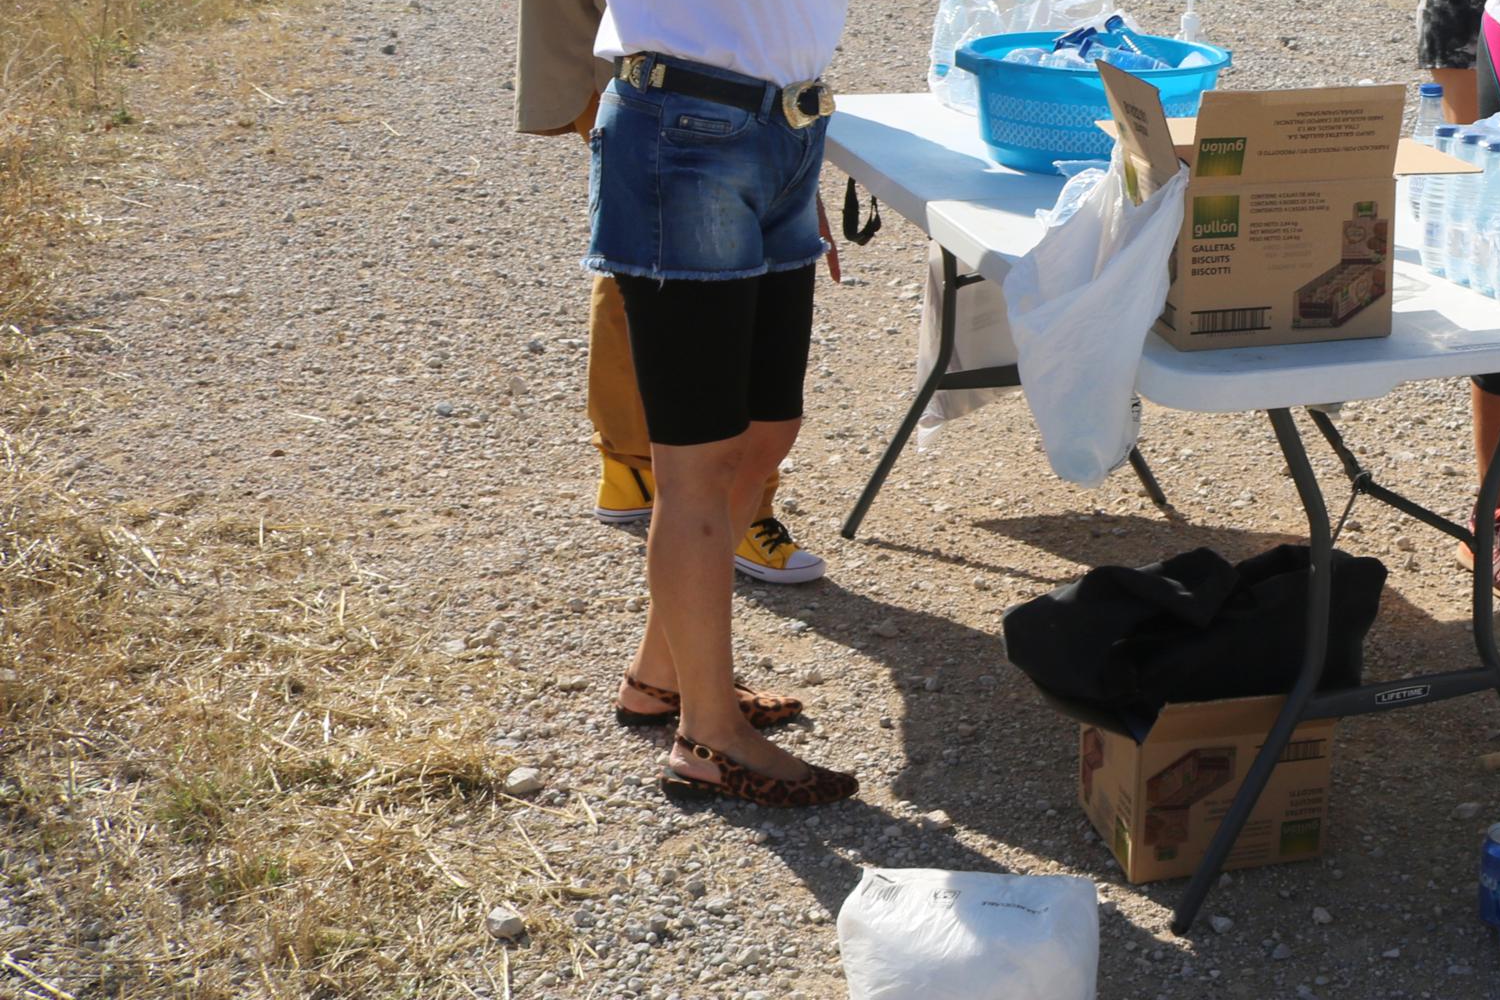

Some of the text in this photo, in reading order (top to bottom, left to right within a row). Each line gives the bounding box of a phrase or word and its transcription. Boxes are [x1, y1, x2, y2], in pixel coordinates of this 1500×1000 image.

[1201, 140, 1244, 155] gullón
[1194, 219, 1237, 237] gullón
[1192, 243, 1236, 253] GALLETAS
[1191, 255, 1231, 264] BISCUITS
[1191, 266, 1232, 276] BISCOTTI
[1382, 687, 1424, 702] LIFETIME
